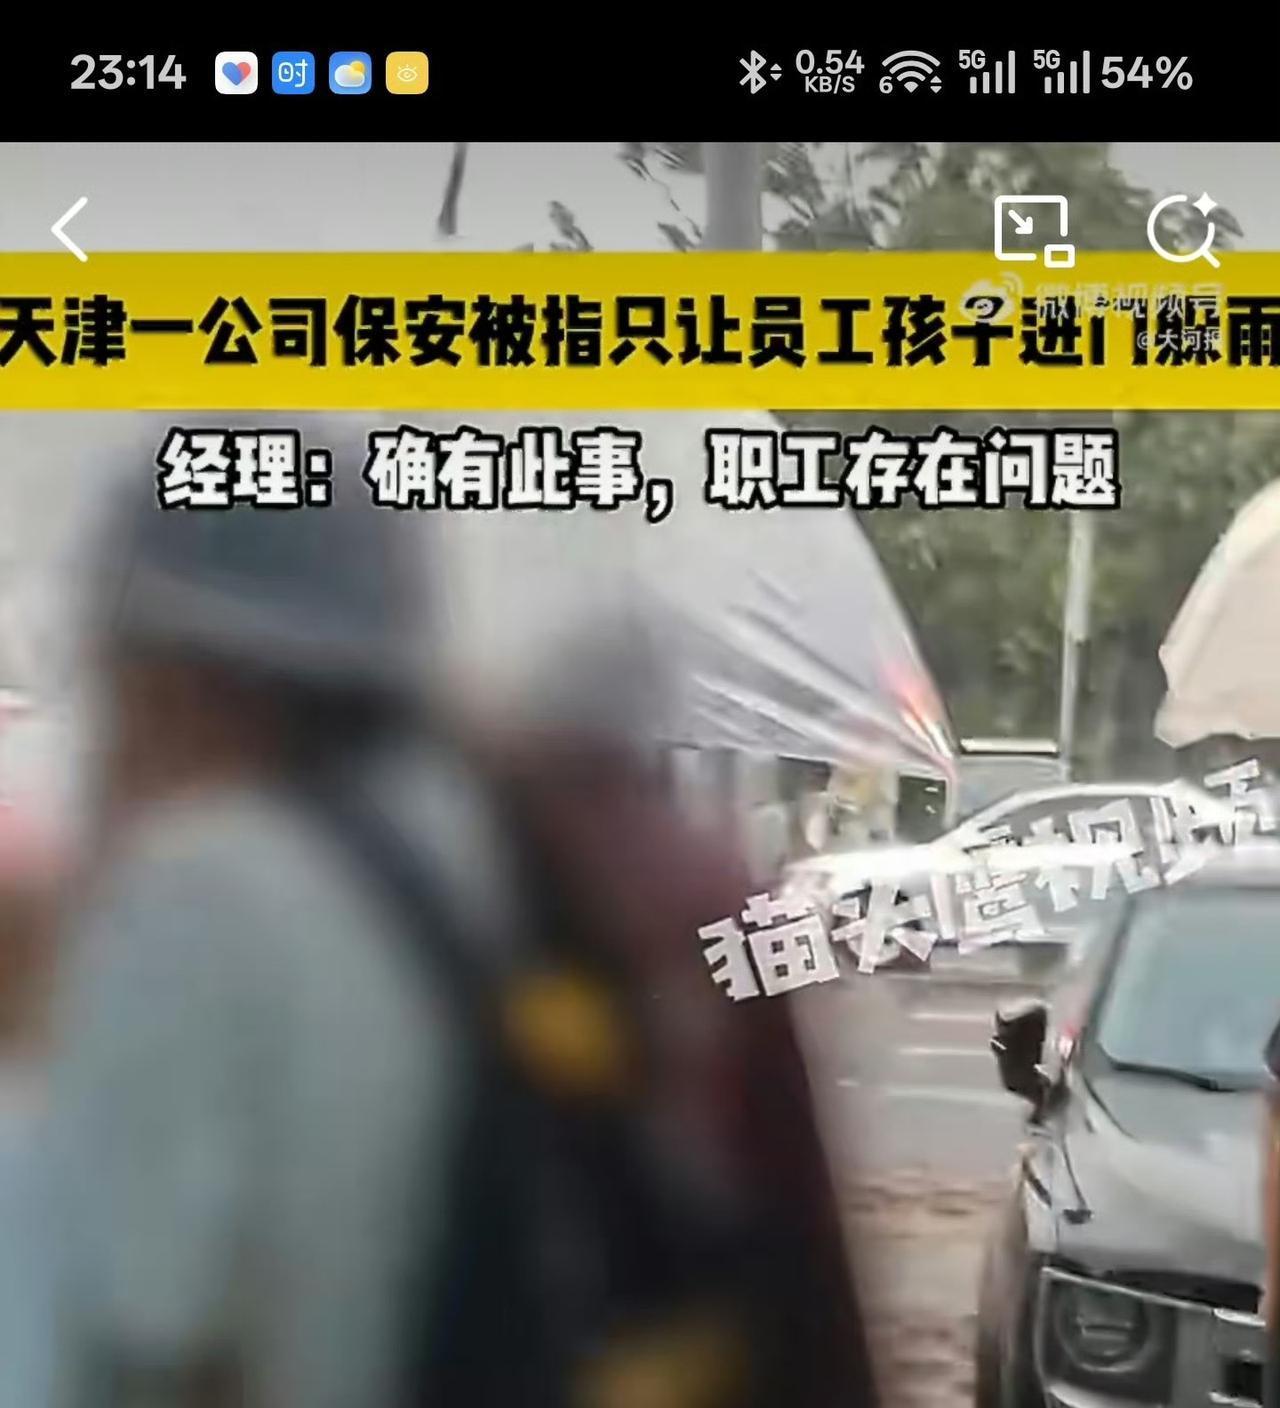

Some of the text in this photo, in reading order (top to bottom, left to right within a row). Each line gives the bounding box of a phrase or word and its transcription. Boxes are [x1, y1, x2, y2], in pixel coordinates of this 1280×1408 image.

[795, 49, 865, 74] 0.54
[958, 50, 987, 70] 5G
[1033, 50, 1062, 70] 5G
[71, 54, 187, 90] 23:14
[1101, 56, 1194, 90] 54%
[804, 75, 856, 95] KB/S
[878, 76, 894, 94] 6
